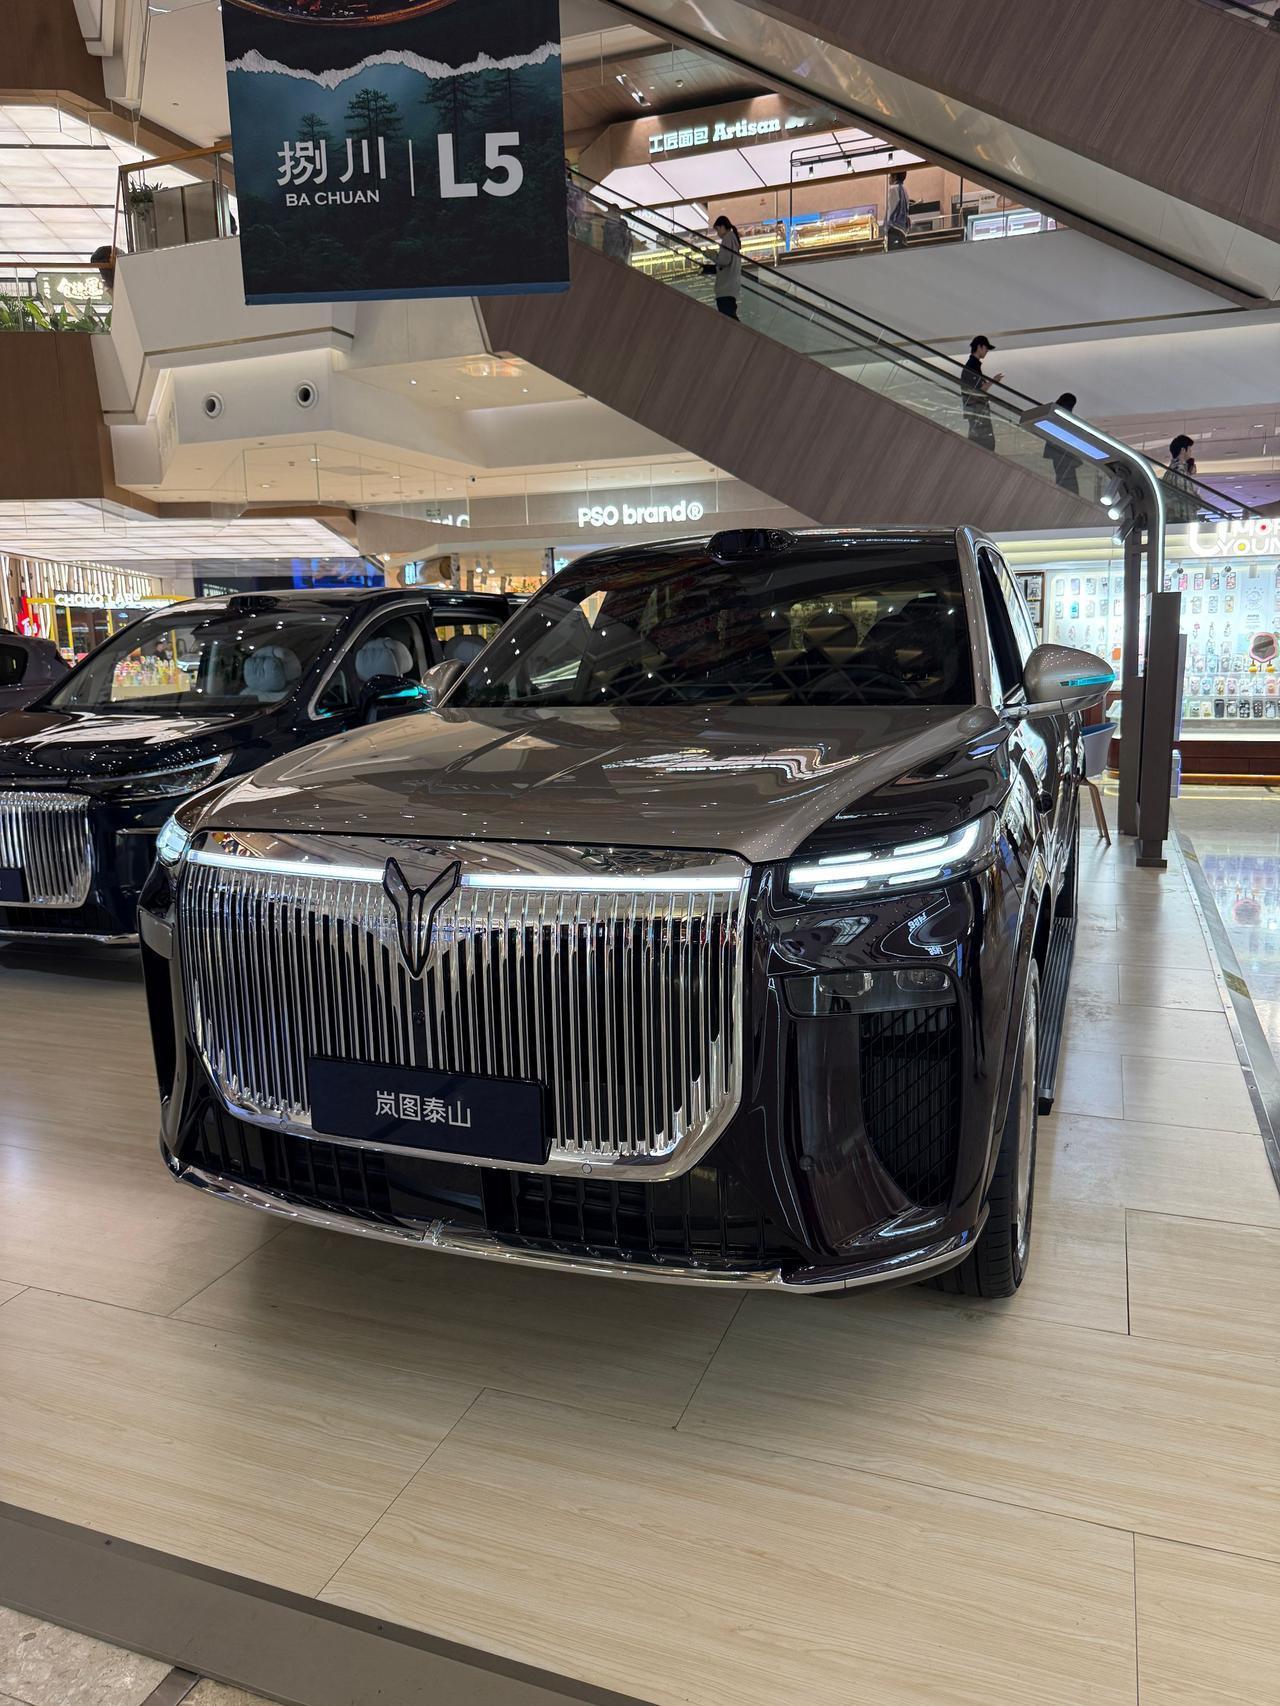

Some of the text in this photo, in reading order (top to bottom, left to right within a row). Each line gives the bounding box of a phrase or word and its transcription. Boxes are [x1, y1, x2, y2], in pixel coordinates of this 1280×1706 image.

[649, 126, 709, 154] 工匠面包
[712, 117, 781, 142] Artisan
[277, 131, 524, 198] 捌川 L5
[286, 190, 380, 207] BA CHUAN
[578, 504, 620, 528] PSO
[375, 1090, 471, 1128] 岚图泰山
